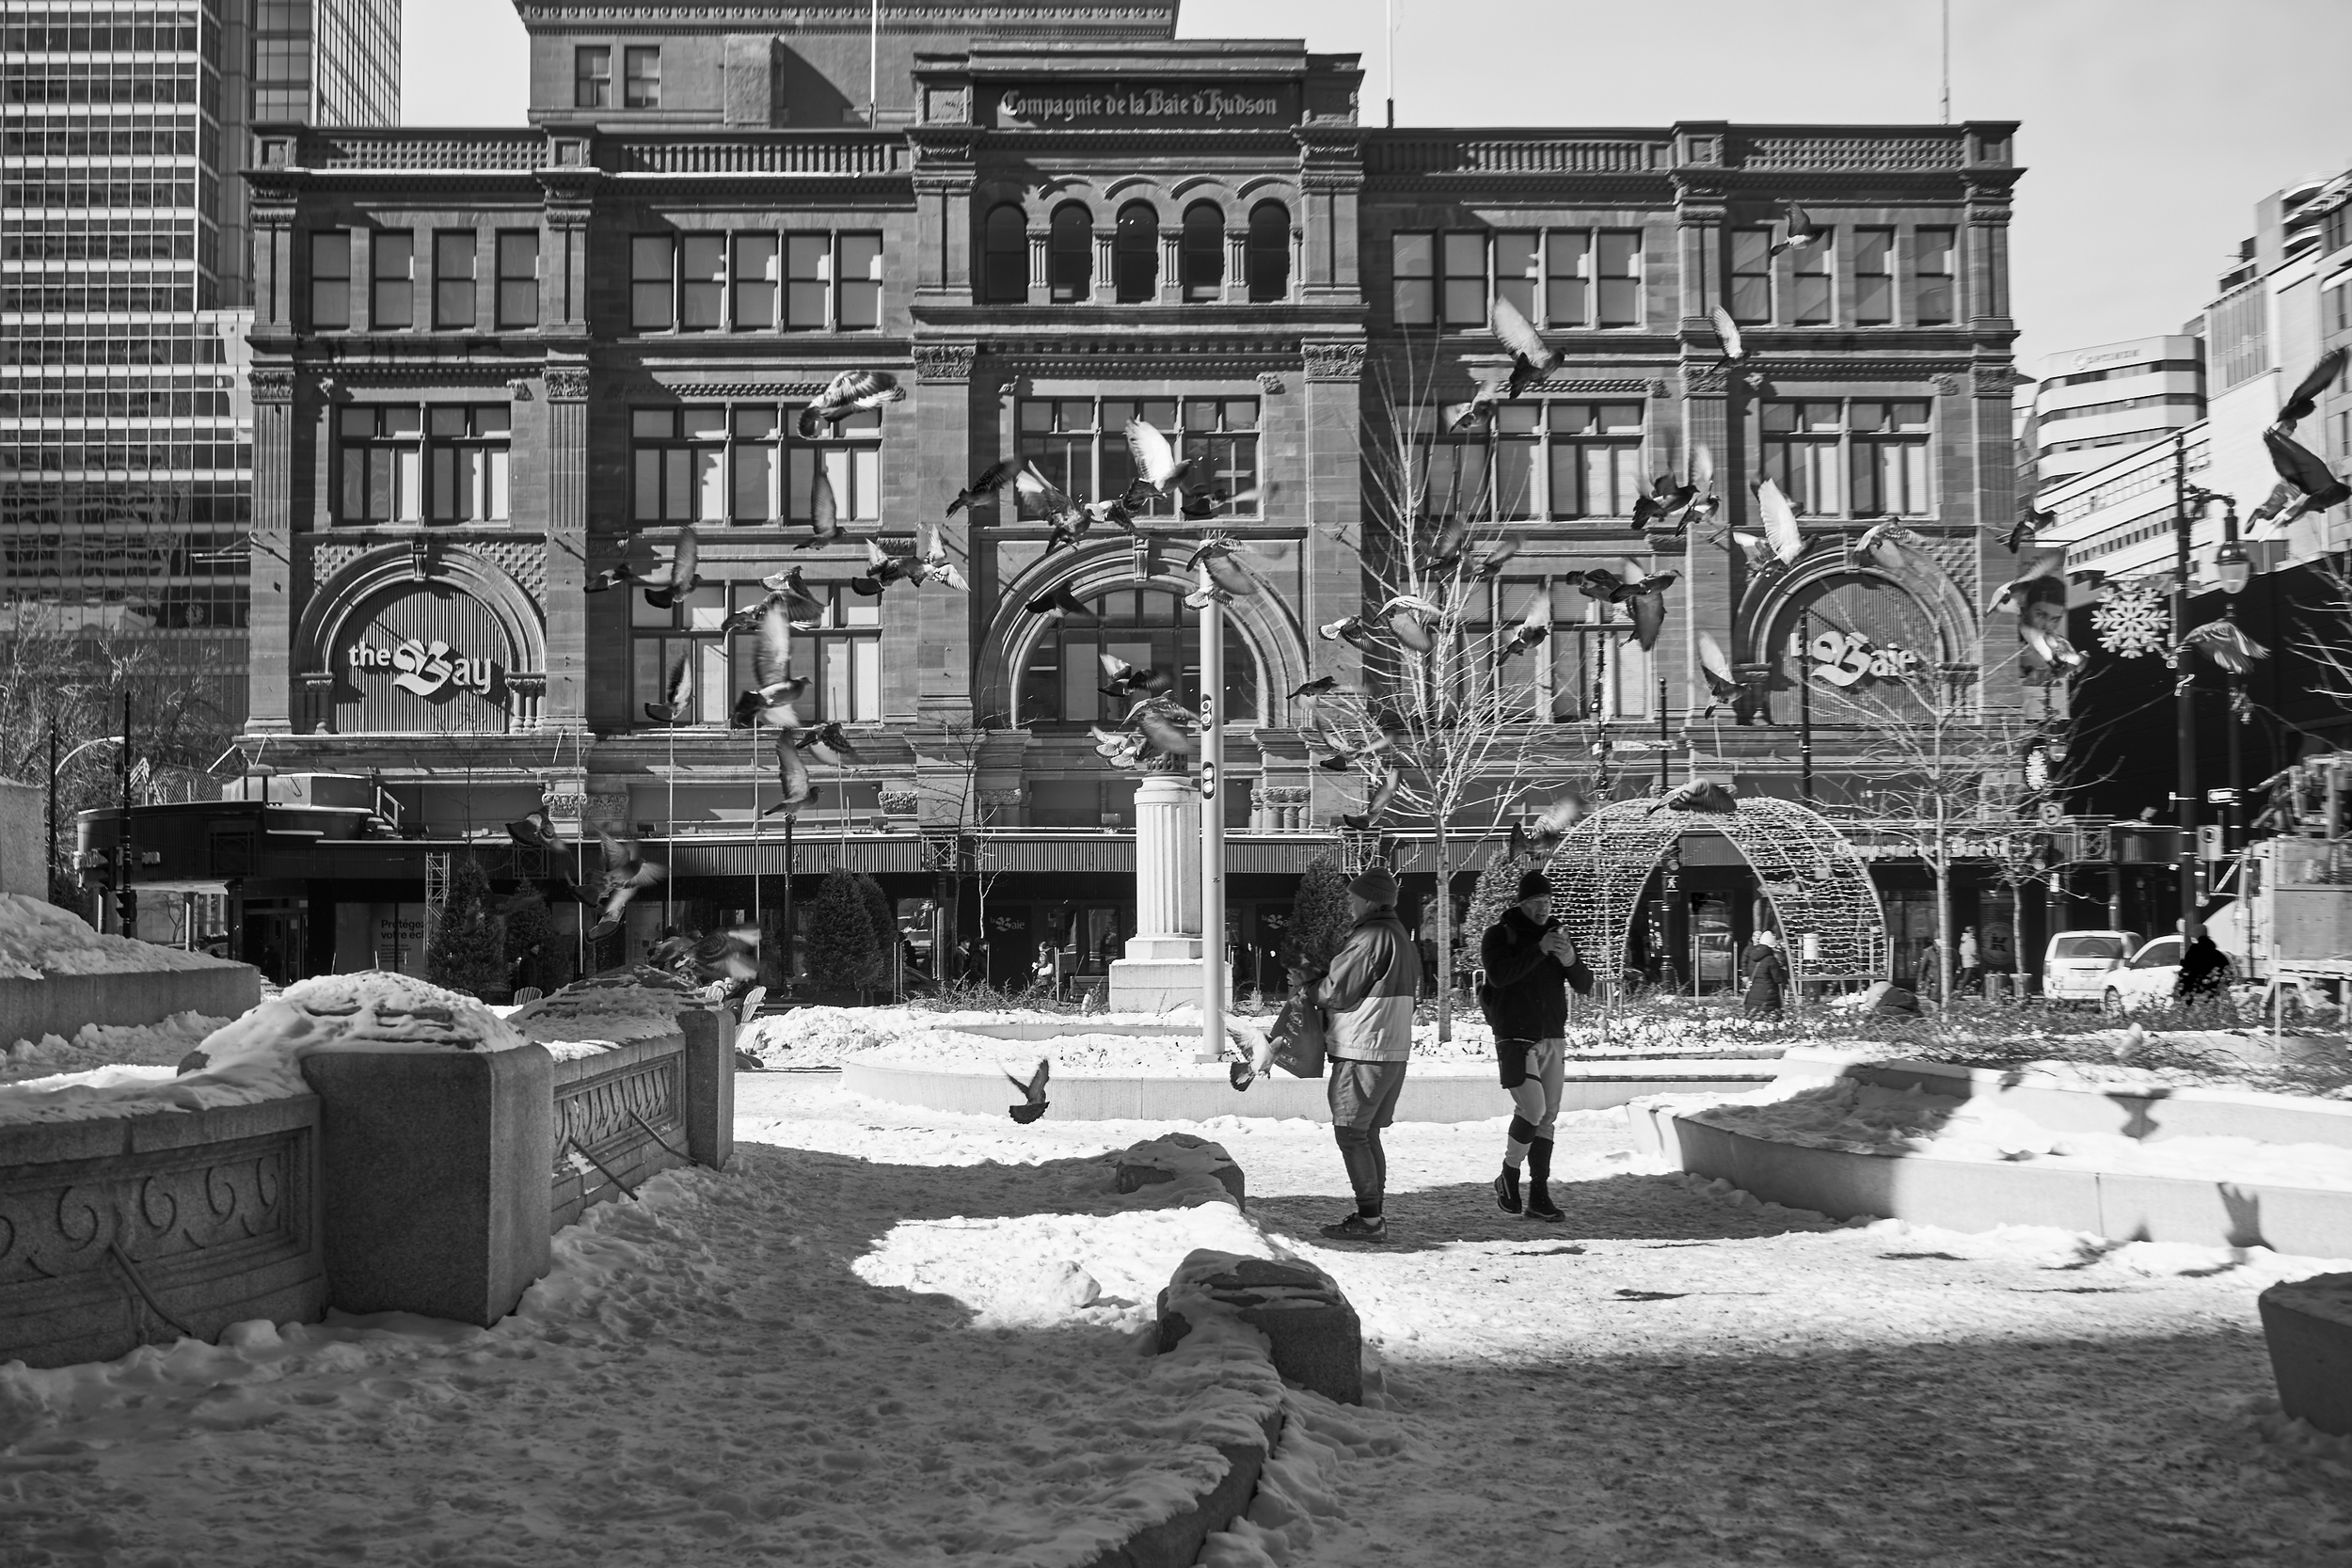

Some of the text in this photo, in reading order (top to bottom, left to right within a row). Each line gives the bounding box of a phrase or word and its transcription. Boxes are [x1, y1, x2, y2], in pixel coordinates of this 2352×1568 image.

[1000, 88, 1101, 121] Compagnie
[1104, 94, 1126, 115] de
[1129, 92, 1145, 116] la
[1144, 87, 1189, 116] Baie
[348, 639, 491, 696] the Bay
[1811, 630, 1918, 687] Baie
[995, 916, 1025, 932] Baie
[1267, 913, 1289, 929] Ba
